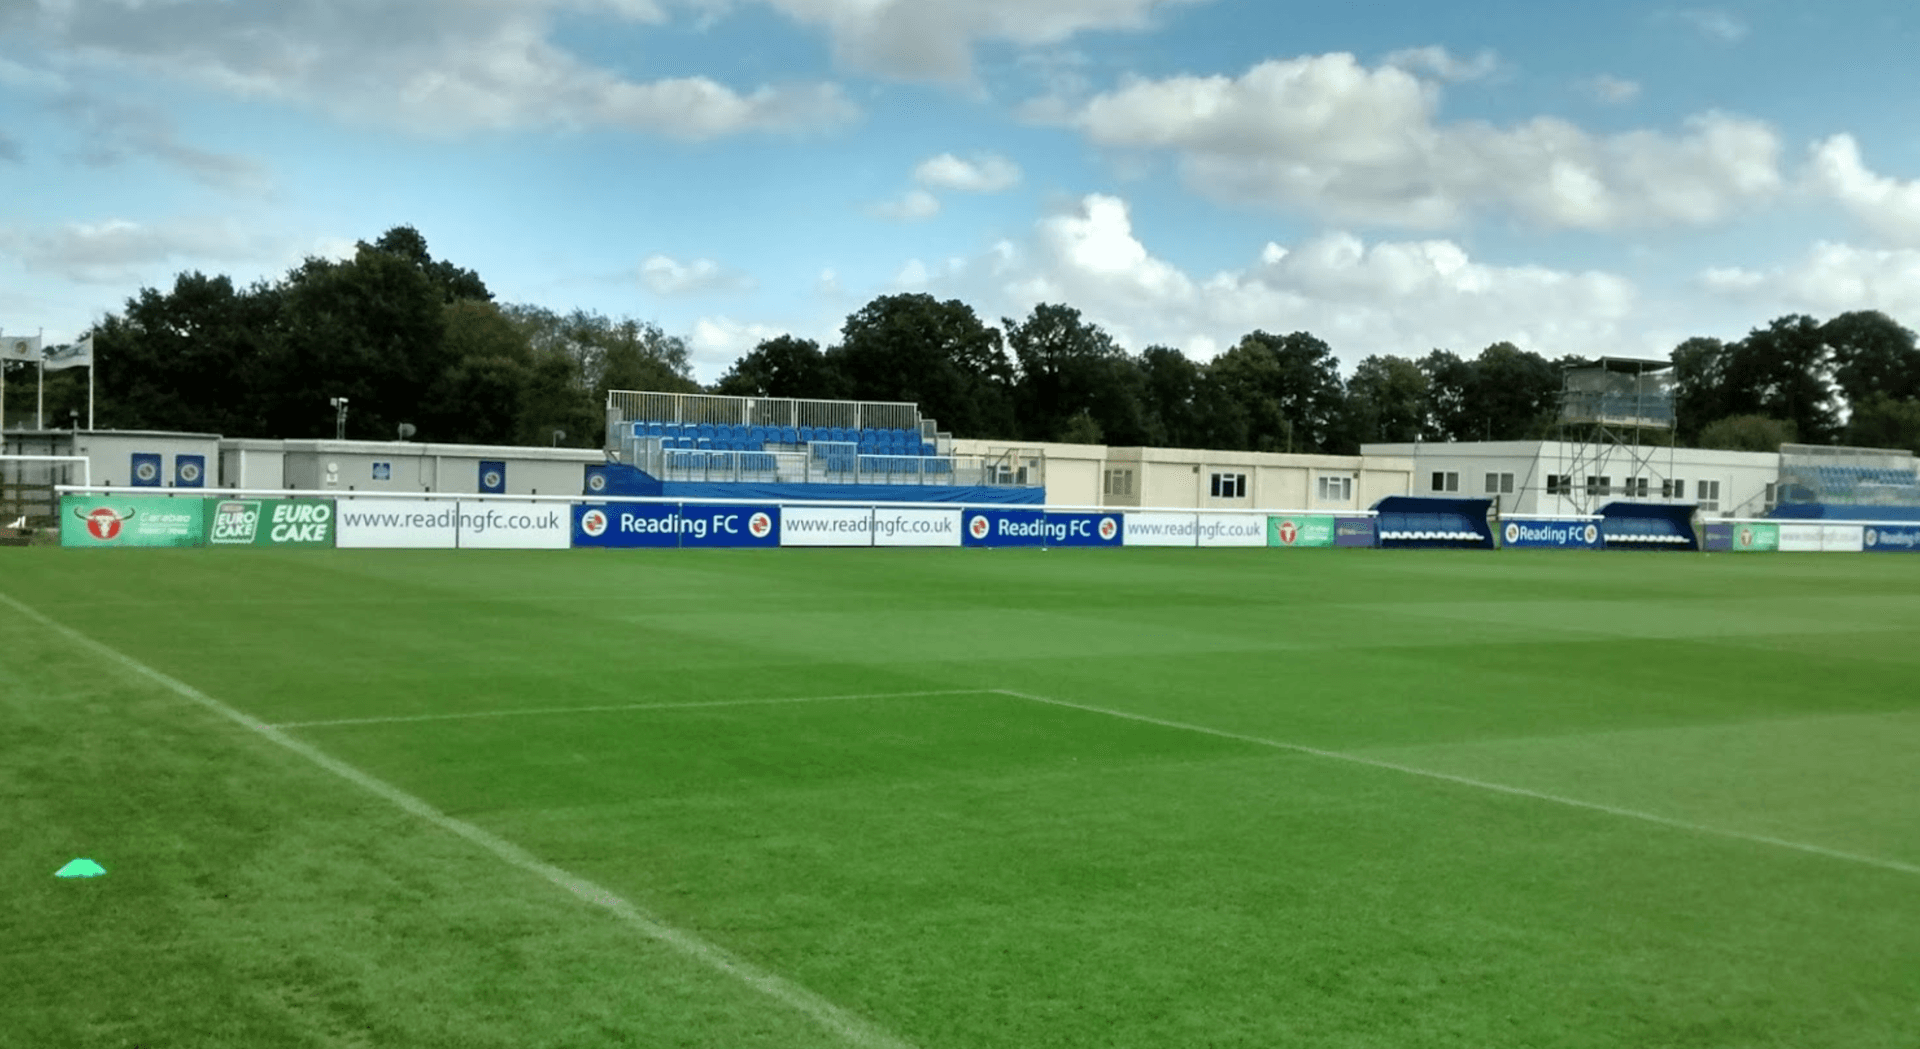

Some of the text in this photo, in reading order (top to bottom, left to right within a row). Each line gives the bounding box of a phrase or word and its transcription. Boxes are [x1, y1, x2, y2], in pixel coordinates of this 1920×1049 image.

[218, 511, 256, 526] EURO
[272, 504, 330, 523] EURO
[343, 509, 559, 533] www.readingfc.co.uk
[216, 523, 253, 537] CAKE
[270, 524, 328, 542] CAKE
[620, 513, 739, 538] Reading FC
[786, 516, 952, 537] www.readingfc.co.uk
[998, 518, 1092, 541] Reading FC
[1128, 521, 1261, 540] www.readingfc.co.uk
[1519, 525, 1584, 544] Reading FC
